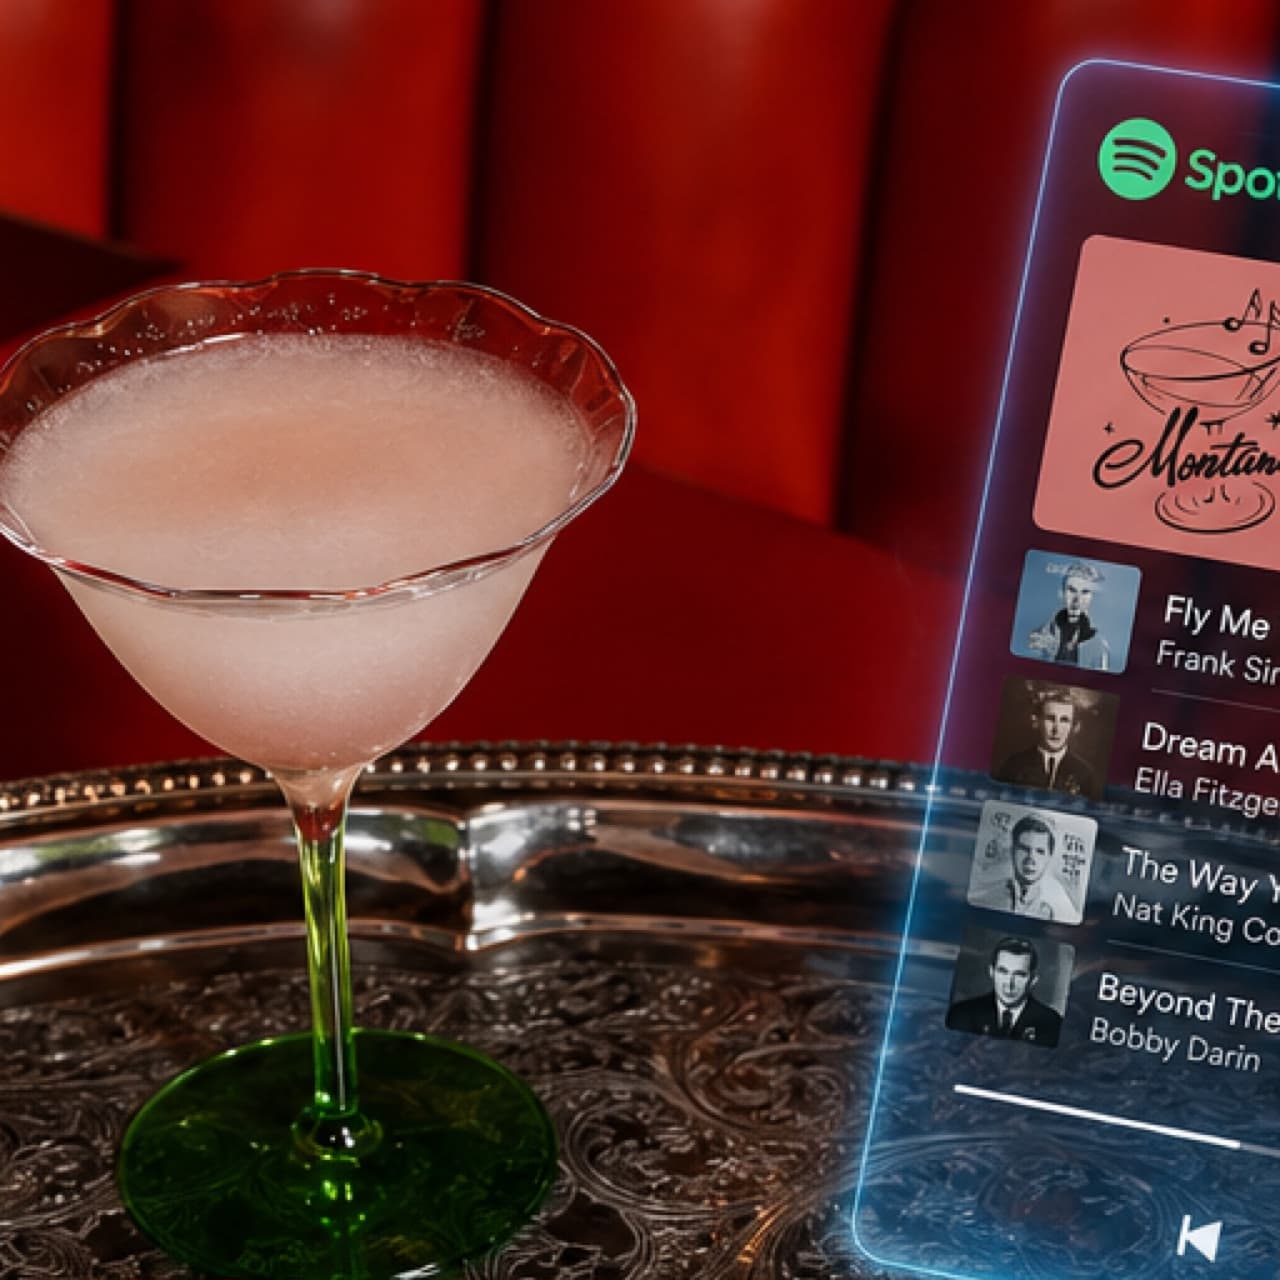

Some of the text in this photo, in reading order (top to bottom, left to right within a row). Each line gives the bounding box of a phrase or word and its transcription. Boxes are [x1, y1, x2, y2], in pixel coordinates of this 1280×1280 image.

[1164, 595, 1211, 636] Fly
[1220, 605, 1270, 640] Me
[1157, 640, 1237, 679] Frank
[1141, 722, 1247, 768] Dream
[1254, 744, 1280, 774] A
[1134, 767, 1183, 800] Ella
[1122, 846, 1179, 886] The
[1189, 860, 1259, 904] Way
[1113, 892, 1163, 925] Nat
[1171, 906, 1234, 945] King
[1097, 973, 1216, 1023] Beyond
[1090, 1019, 1262, 1074] Bobby Darin
